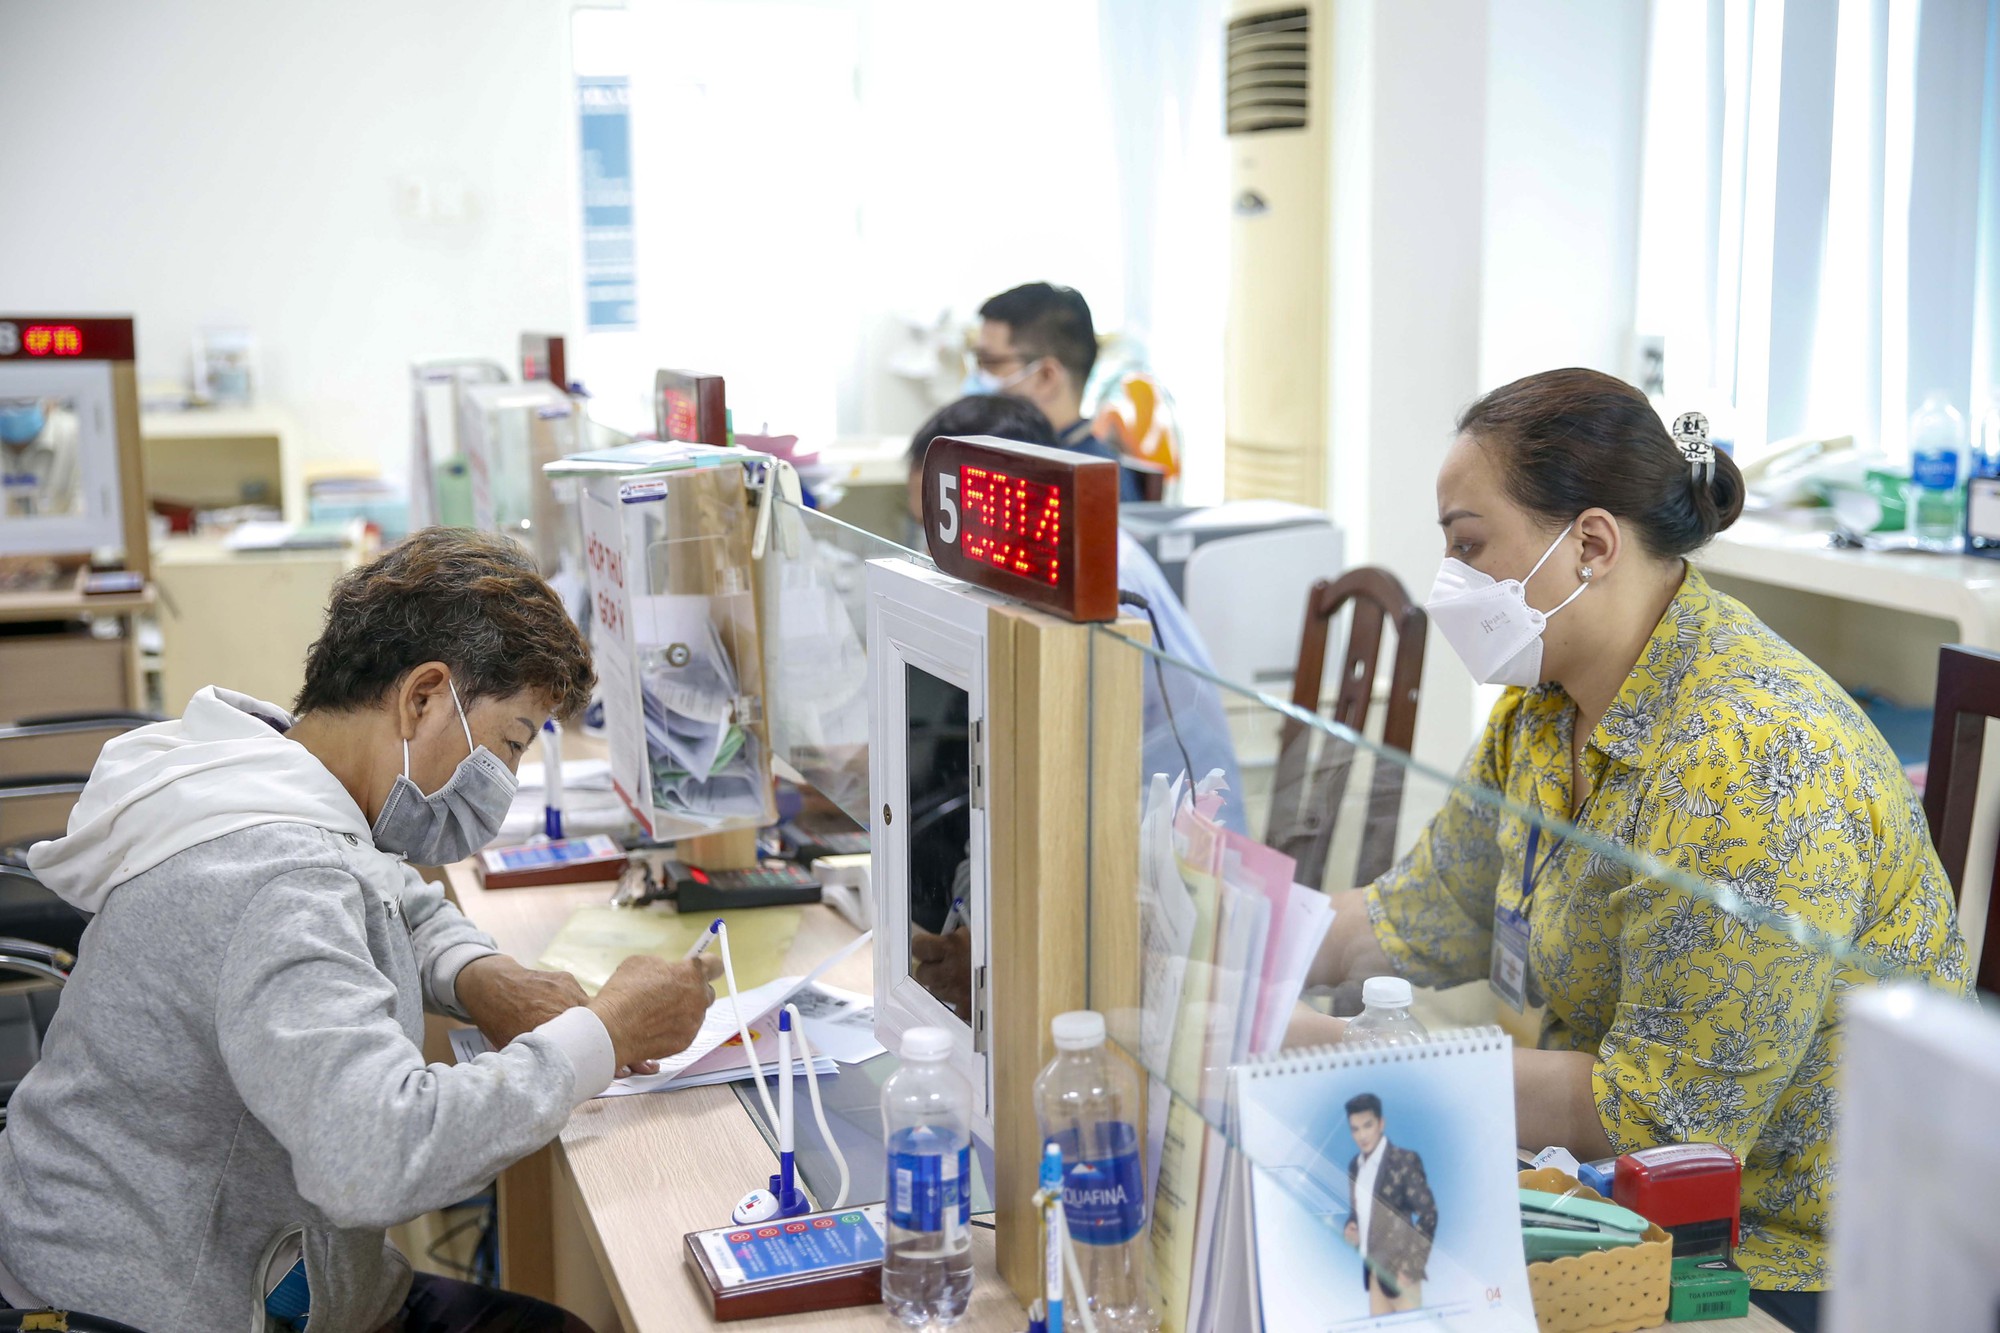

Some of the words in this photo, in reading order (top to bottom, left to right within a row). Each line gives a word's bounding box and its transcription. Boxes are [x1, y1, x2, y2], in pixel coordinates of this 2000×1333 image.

[939, 472, 958, 544] 5
[1063, 1183, 1128, 1208] QUAFINA
[1485, 1287, 1501, 1301] 04
